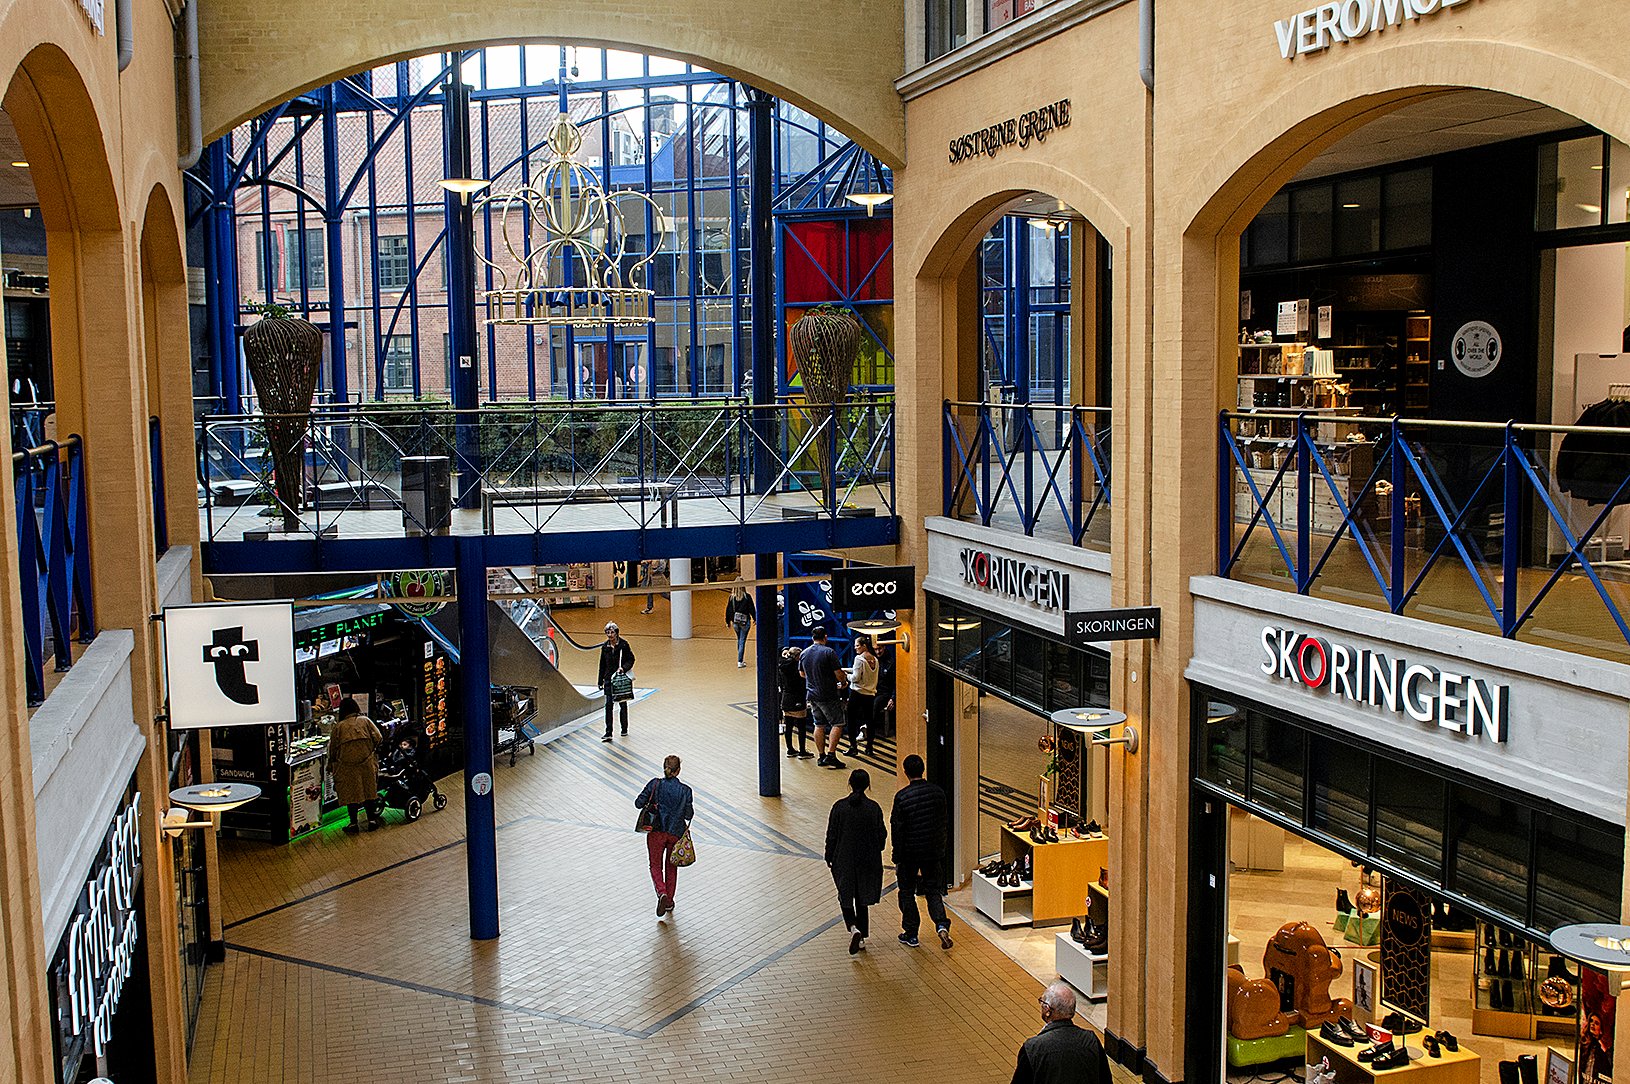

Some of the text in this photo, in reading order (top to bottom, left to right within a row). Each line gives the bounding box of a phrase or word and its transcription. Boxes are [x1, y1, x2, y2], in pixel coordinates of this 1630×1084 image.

[1274, 0, 1467, 59] VEROM
[949, 98, 1071, 163] SØSTRENE GRENE
[851, 581, 897, 596] ecco
[959, 547, 1070, 612] SKORINGEN
[336, 613, 384, 635] PLANET
[1076, 617, 1156, 635] SKORINGEN
[1260, 625, 1510, 744] SKORINGEN
[267, 725, 278, 782] AFFE
[220, 768, 255, 779] SANDWICH
[1392, 908, 1418, 929] NEWS
